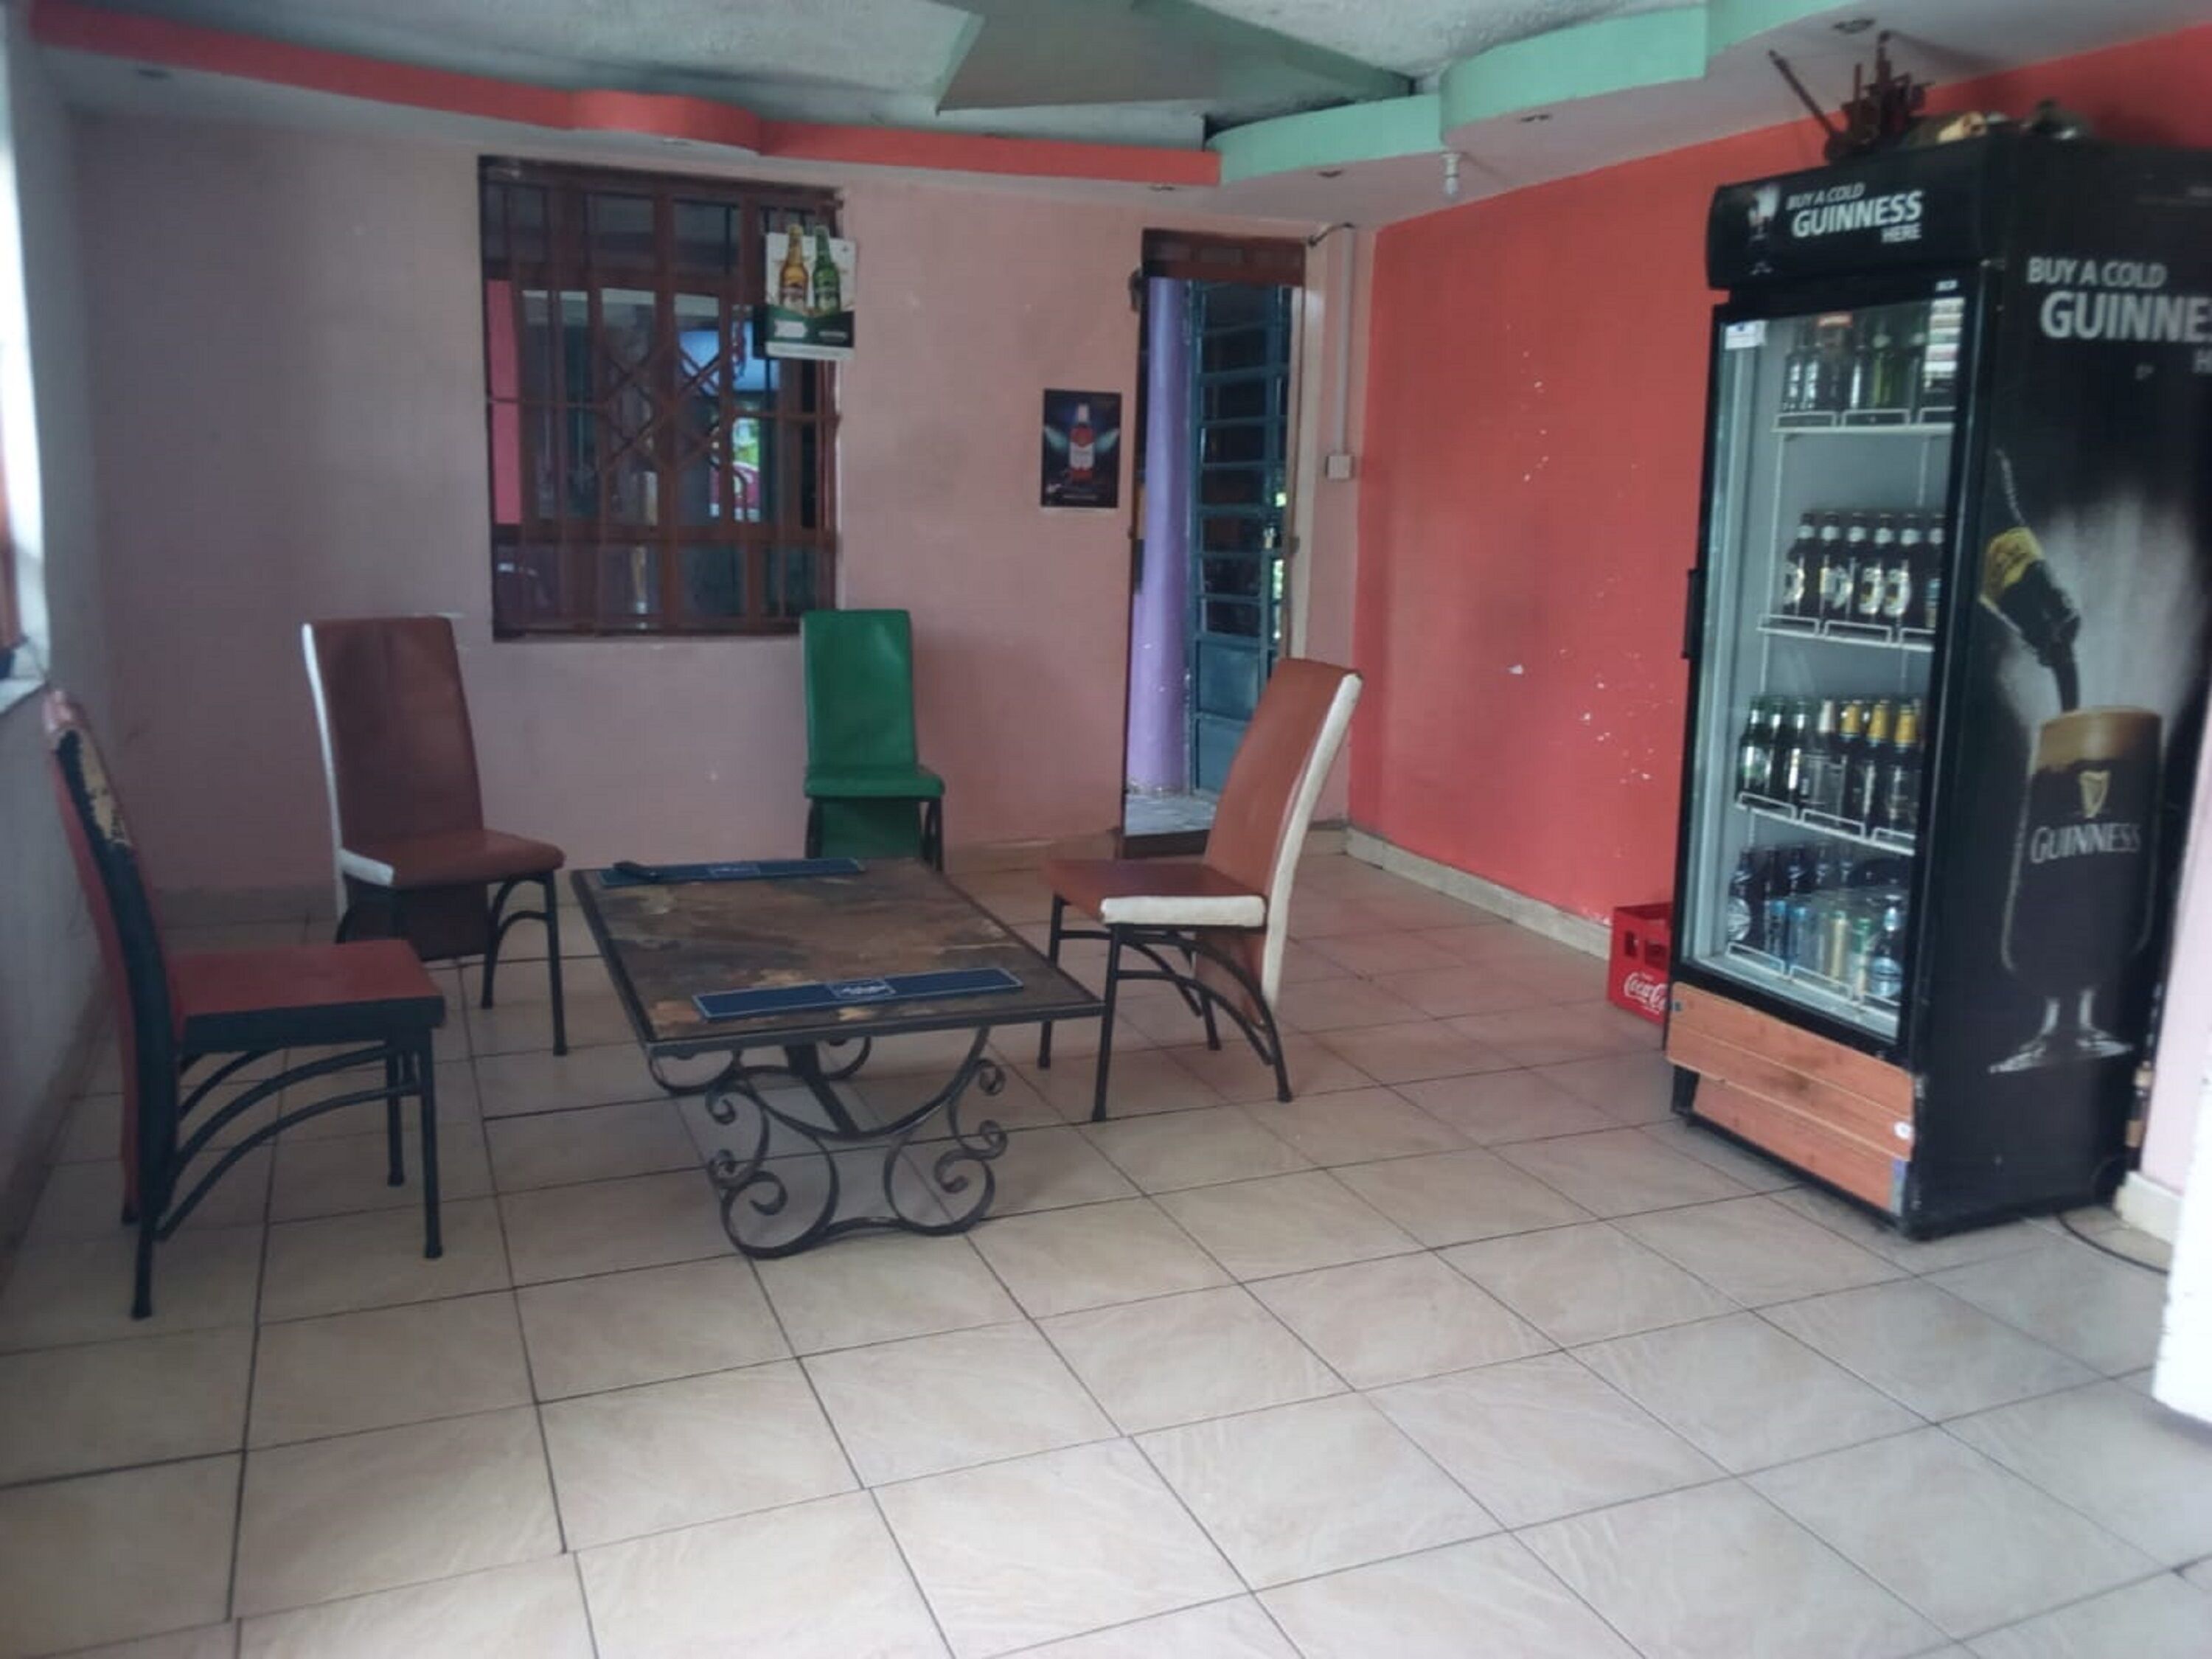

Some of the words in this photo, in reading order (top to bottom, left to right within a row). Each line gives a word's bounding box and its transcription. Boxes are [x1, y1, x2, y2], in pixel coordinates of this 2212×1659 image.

[1786, 192, 1815, 210] BUY
[1814, 190, 1826, 205] A
[1827, 182, 1865, 202] COLD
[1792, 190, 1924, 238] GUINNESS
[1882, 223, 1921, 243] HERE
[2028, 257, 2077, 283] BUY
[2079, 260, 2098, 285] A
[2103, 261, 2167, 288] COLD
[2040, 290, 2212, 342] GUINNE
[2031, 823, 2141, 863] GUINNESS
